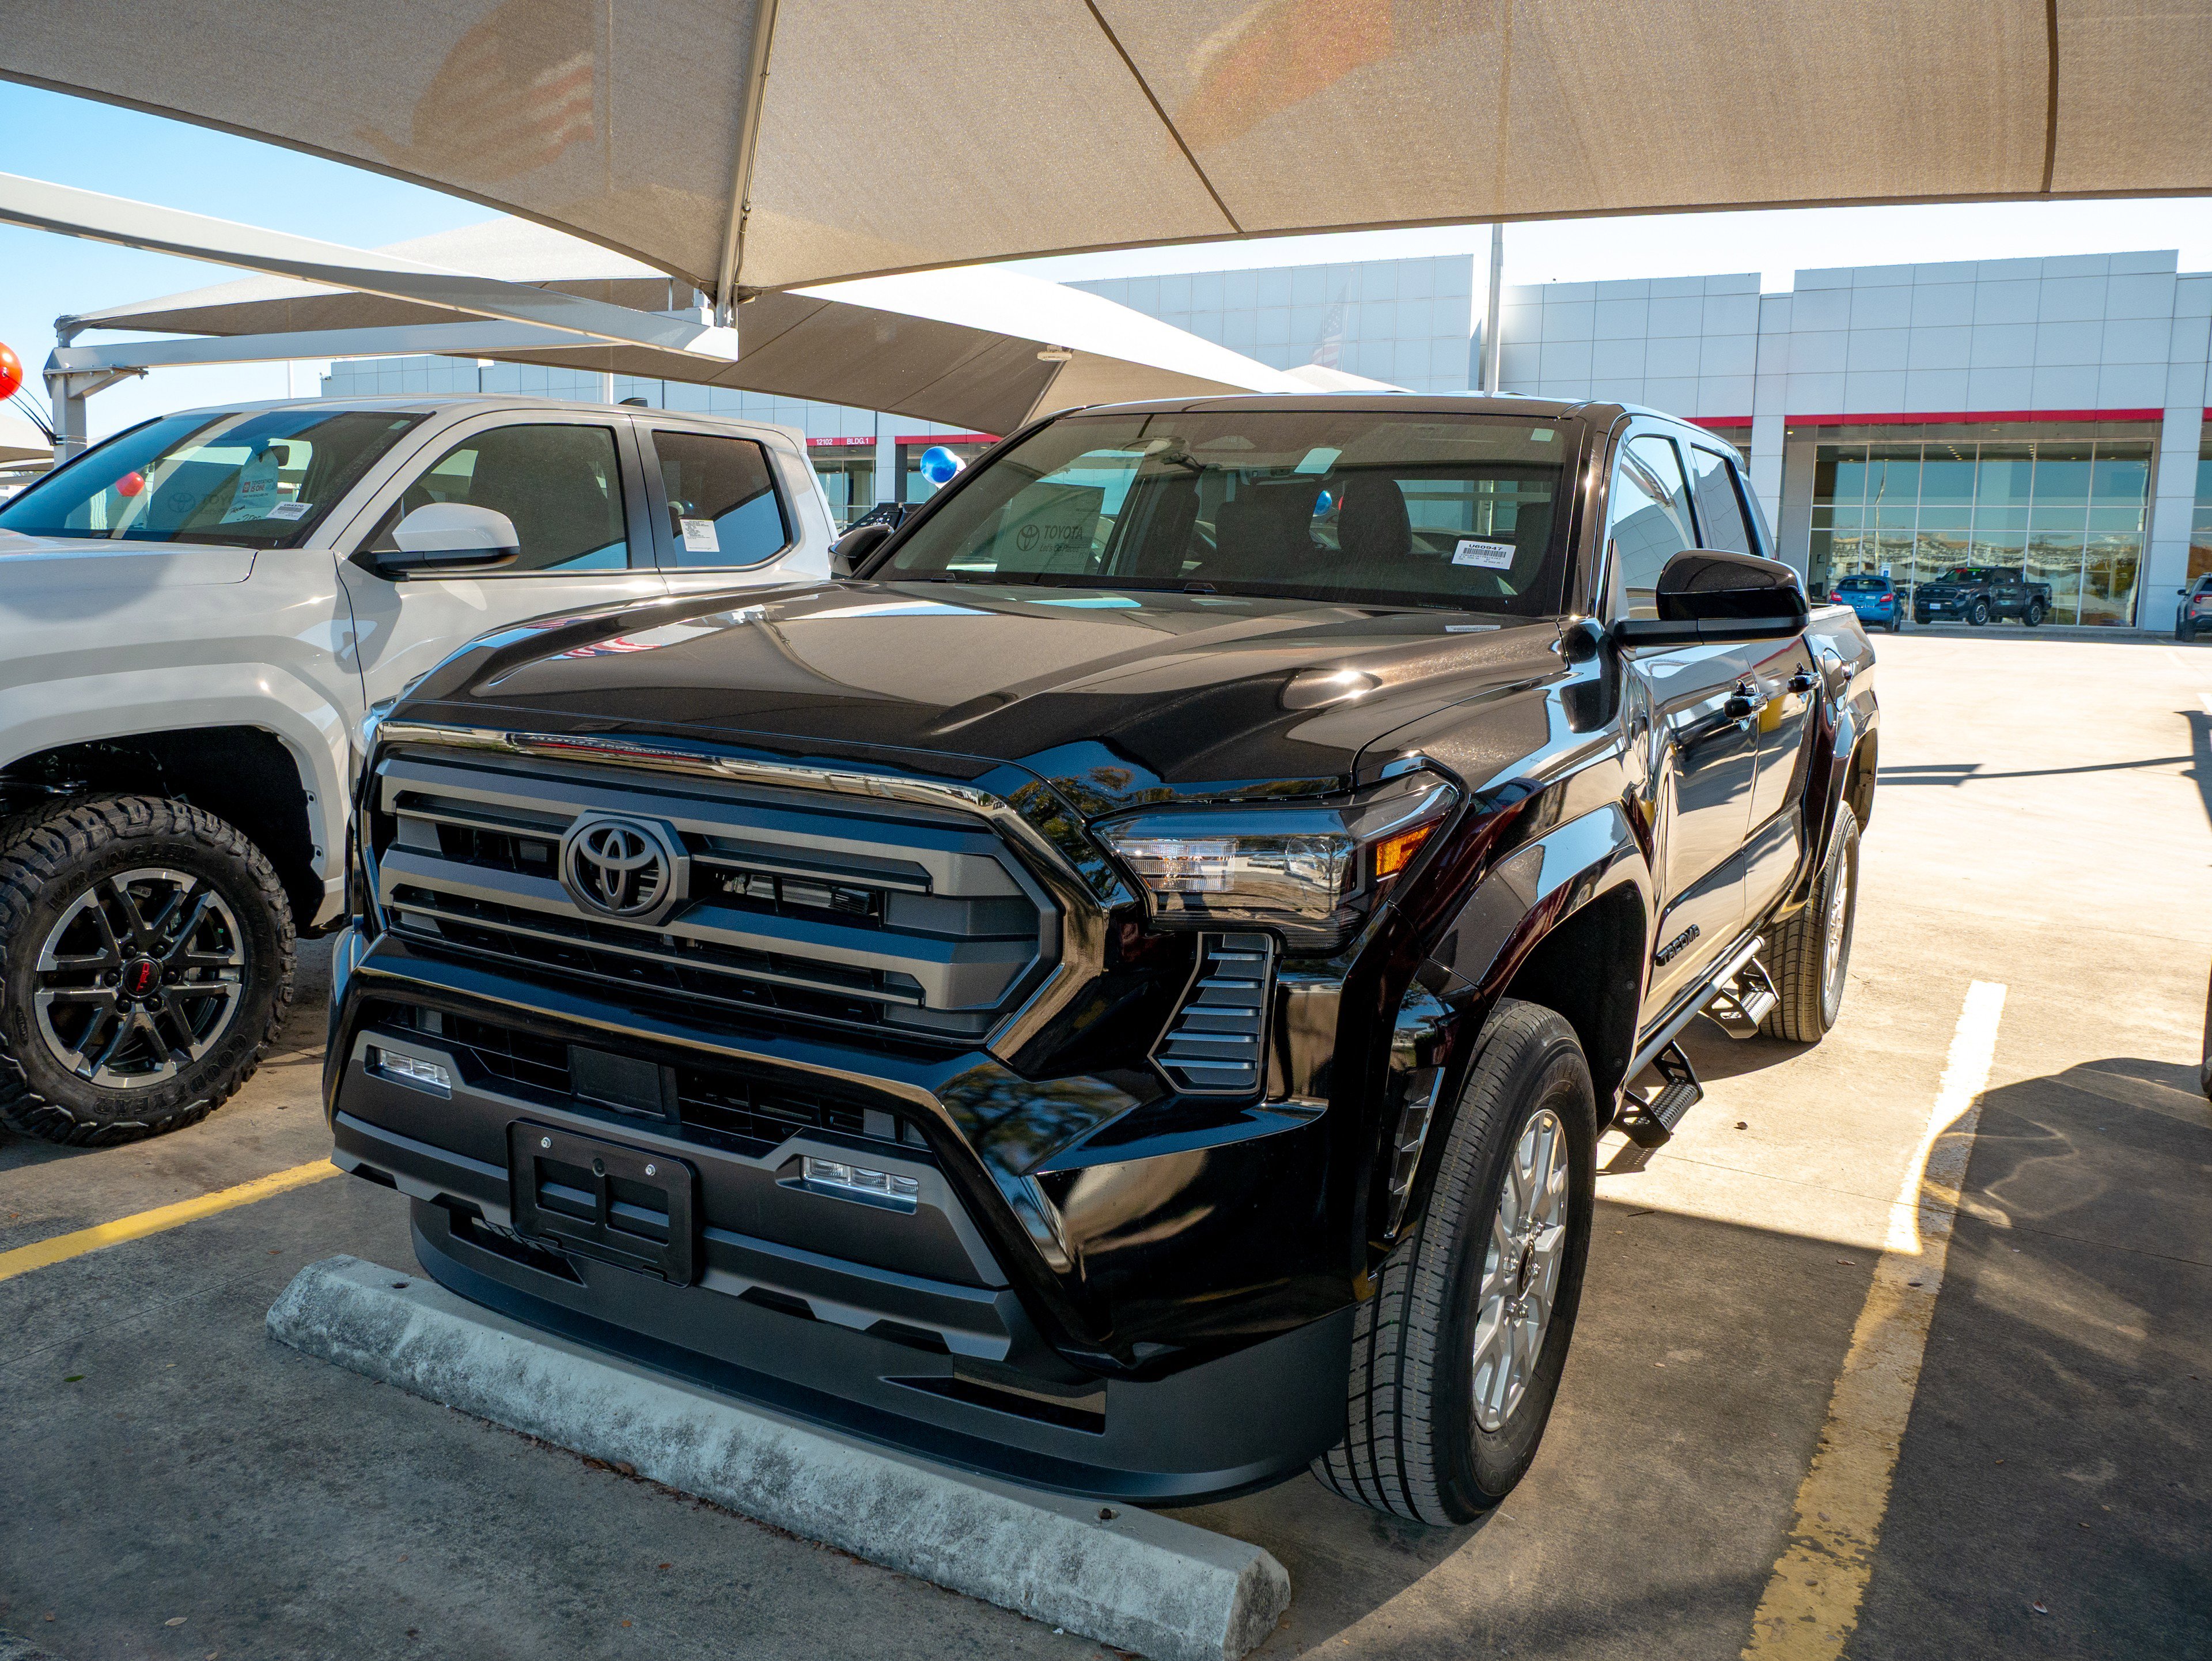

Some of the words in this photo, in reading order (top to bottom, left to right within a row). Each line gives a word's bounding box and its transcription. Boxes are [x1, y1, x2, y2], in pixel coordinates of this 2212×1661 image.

[1044, 525, 1083, 540] TOYOTA
[1656, 924, 1700, 966] TACOMA
[136, 963, 150, 992] TRD
